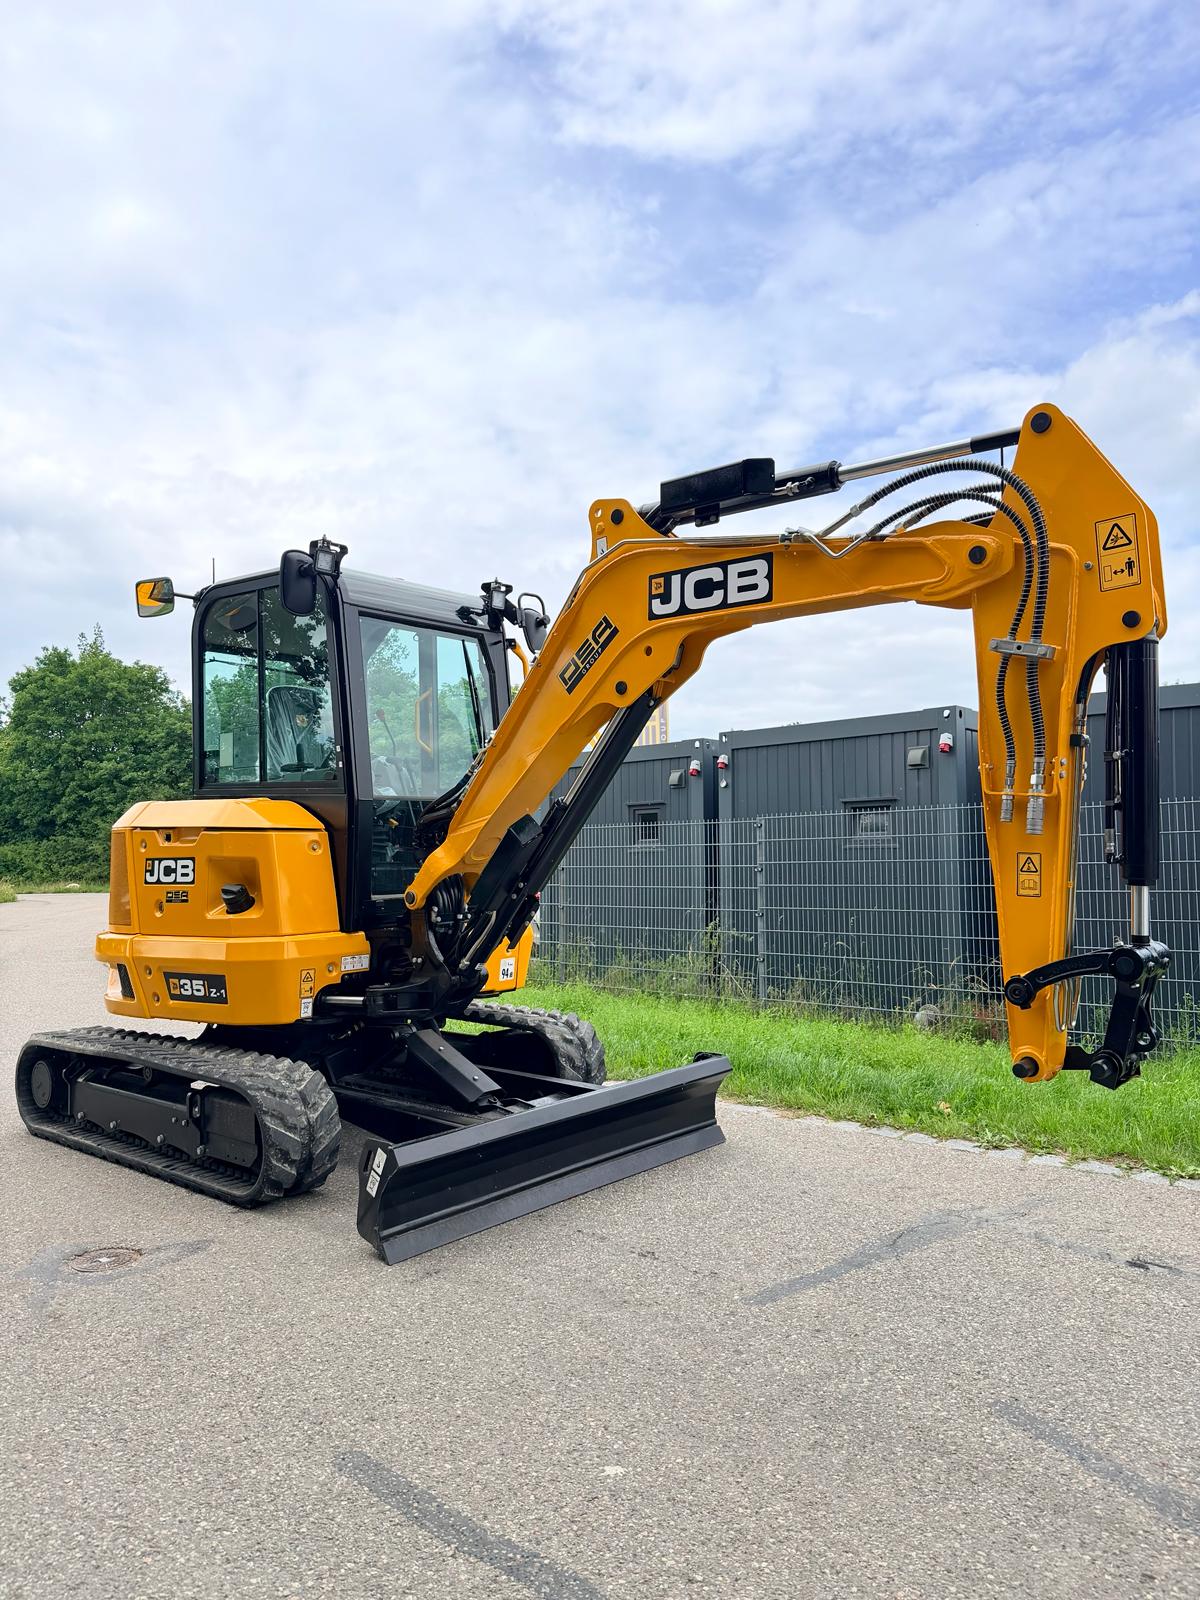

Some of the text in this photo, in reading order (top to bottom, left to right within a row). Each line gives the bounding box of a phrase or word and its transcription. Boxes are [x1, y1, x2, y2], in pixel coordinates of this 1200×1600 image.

[651, 559, 769, 615] JCB
[558, 615, 613, 686] DEA
[581, 647, 602, 674] GROUP
[146, 860, 194, 882] JCB
[502, 968, 509, 979] 94
[179, 978, 205, 996] 35
